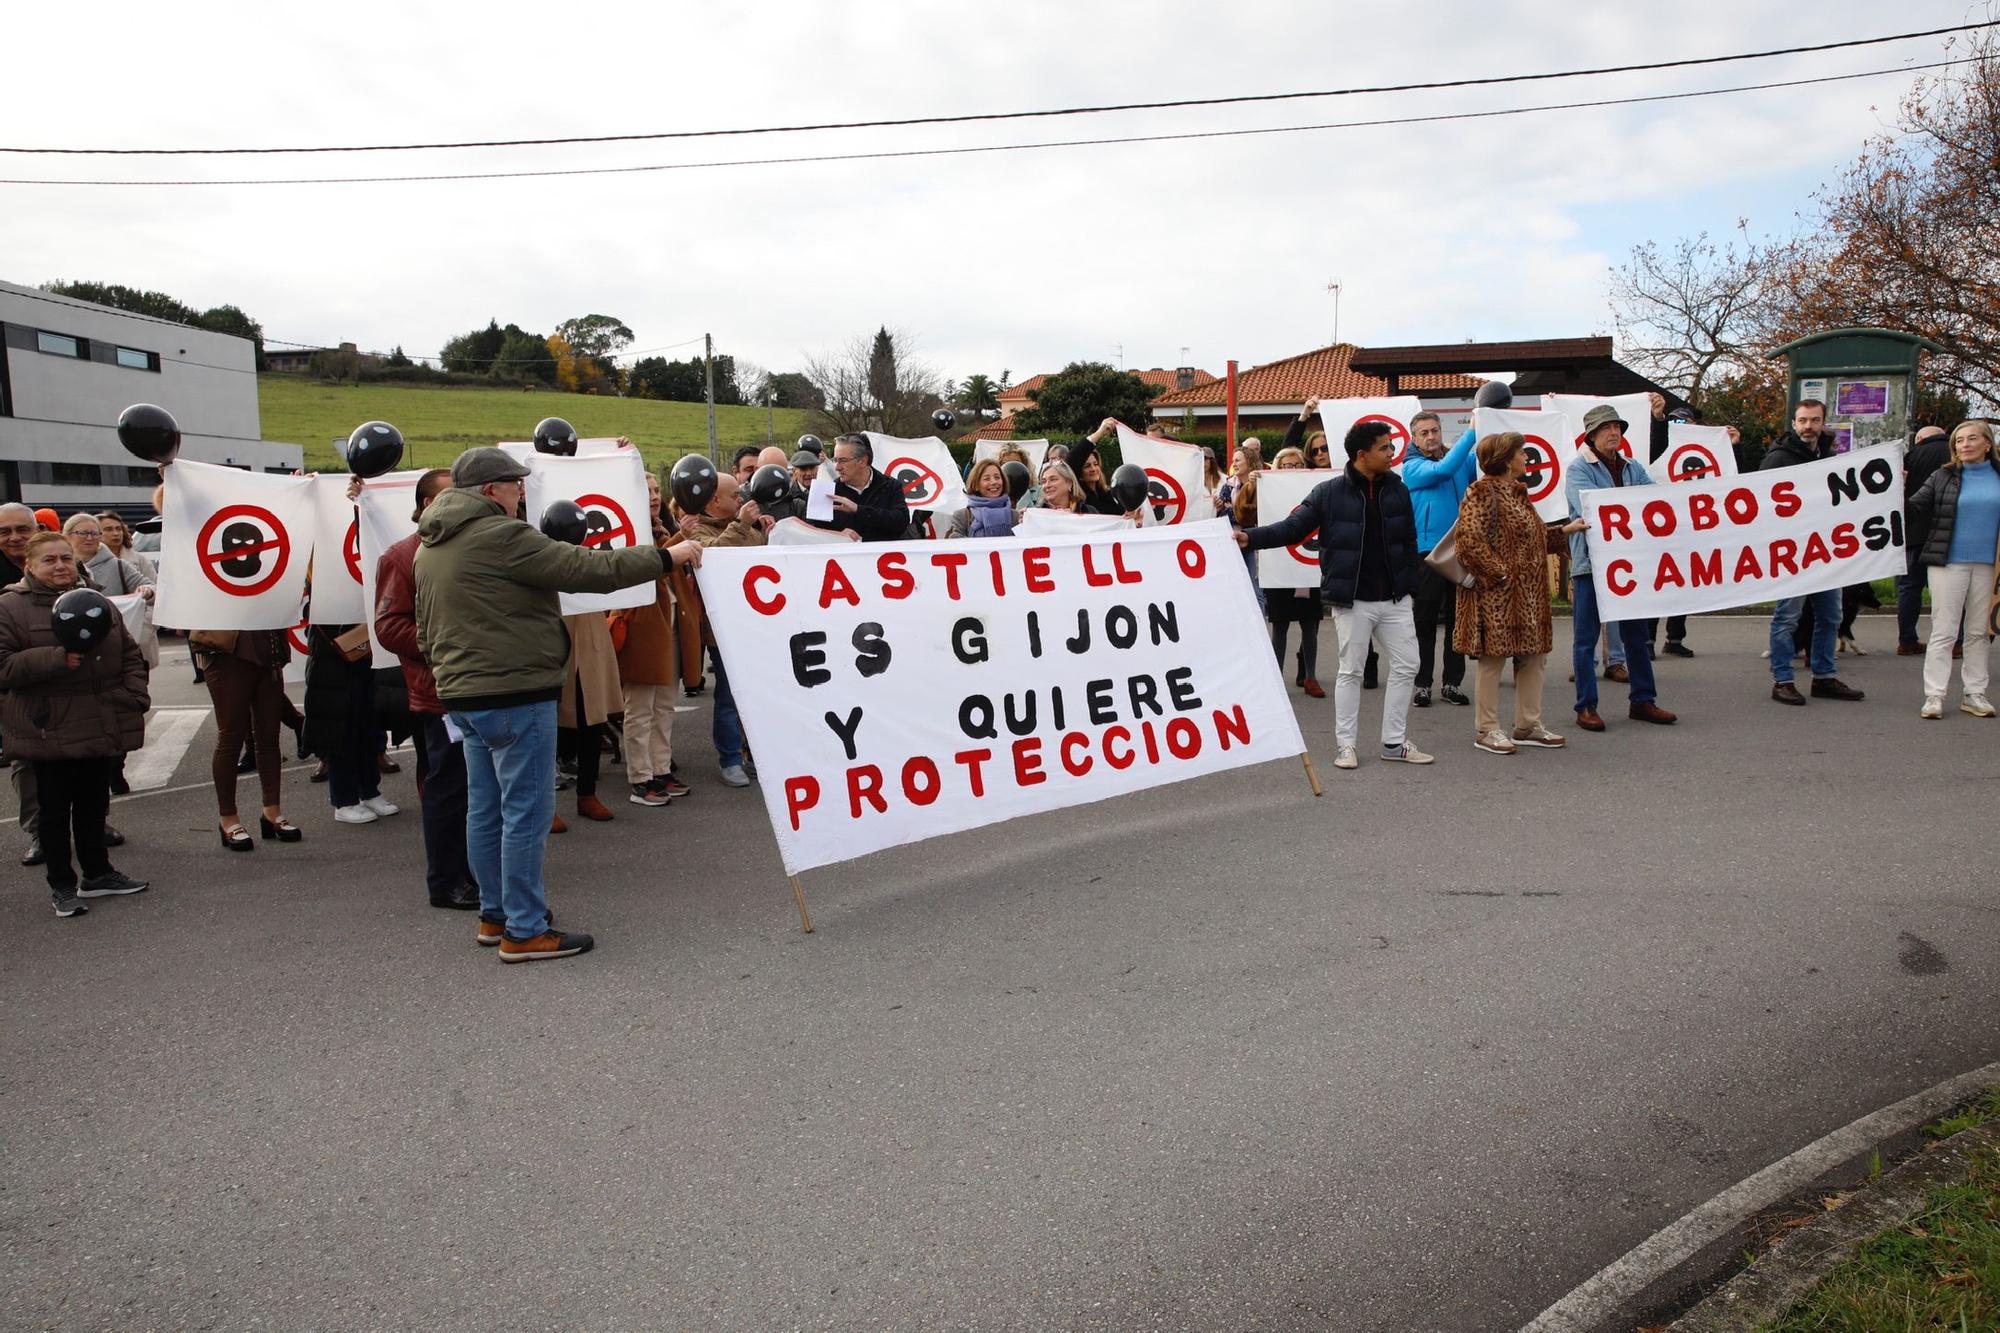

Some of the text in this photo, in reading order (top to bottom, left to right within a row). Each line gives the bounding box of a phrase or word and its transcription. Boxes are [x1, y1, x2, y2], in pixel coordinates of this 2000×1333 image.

[1598, 457, 1893, 542] ROBOS NO
[742, 538, 1207, 617] CASTIELLO
[1605, 510, 1905, 597] CAMARAS SI
[789, 601, 1180, 688] ES GIJON
[824, 666, 1203, 761] Y QUIERE
[784, 703, 1252, 831] PROTECCION
